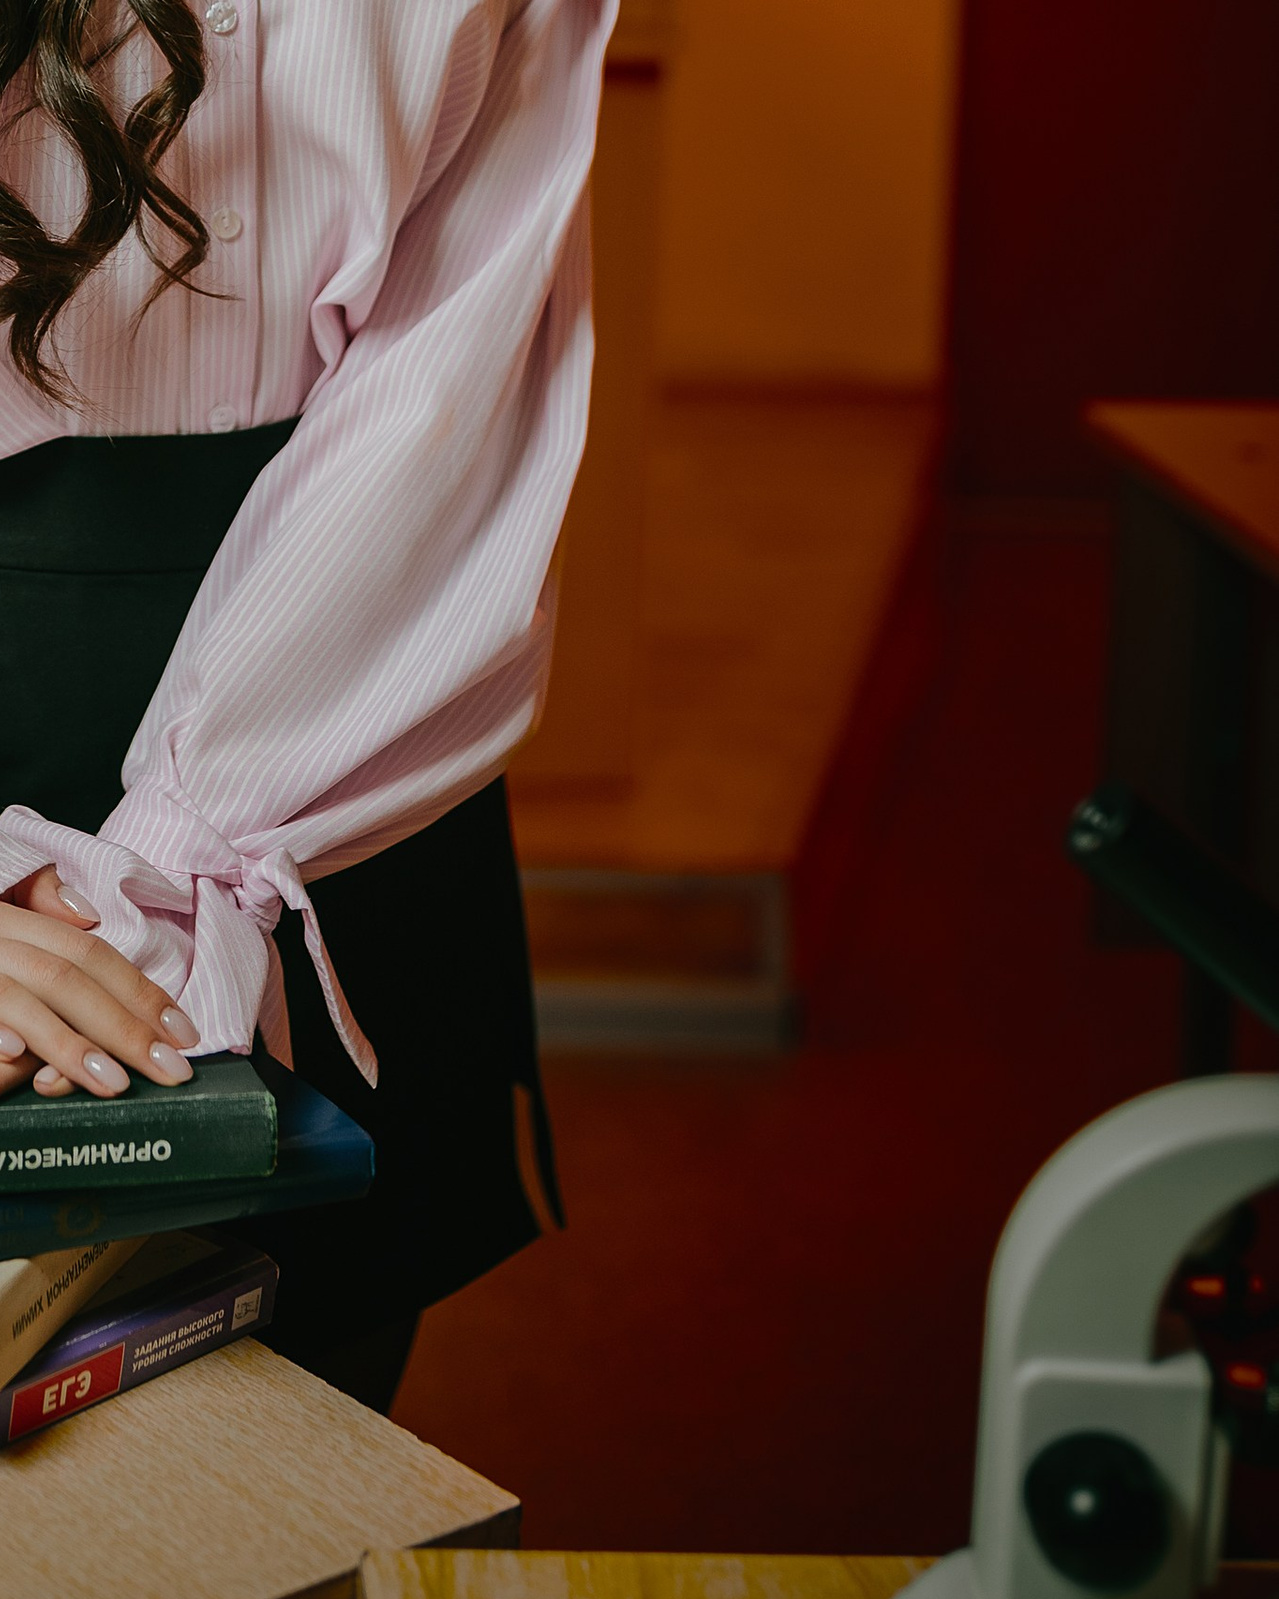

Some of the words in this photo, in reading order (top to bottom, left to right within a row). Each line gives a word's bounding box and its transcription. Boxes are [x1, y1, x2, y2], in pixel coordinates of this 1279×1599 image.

[12, 1294, 44, 1341] ХИМИИ
[133, 1330, 177, 1359] ЗАДАНИЯ
[178, 1309, 225, 1338] ВЫСОКОГО
[132, 1349, 168, 1373] УРОВНЯ
[168, 1323, 223, 1356] СЛОЖНОСТИ
[42, 1369, 92, 1415] ЕГЭ
